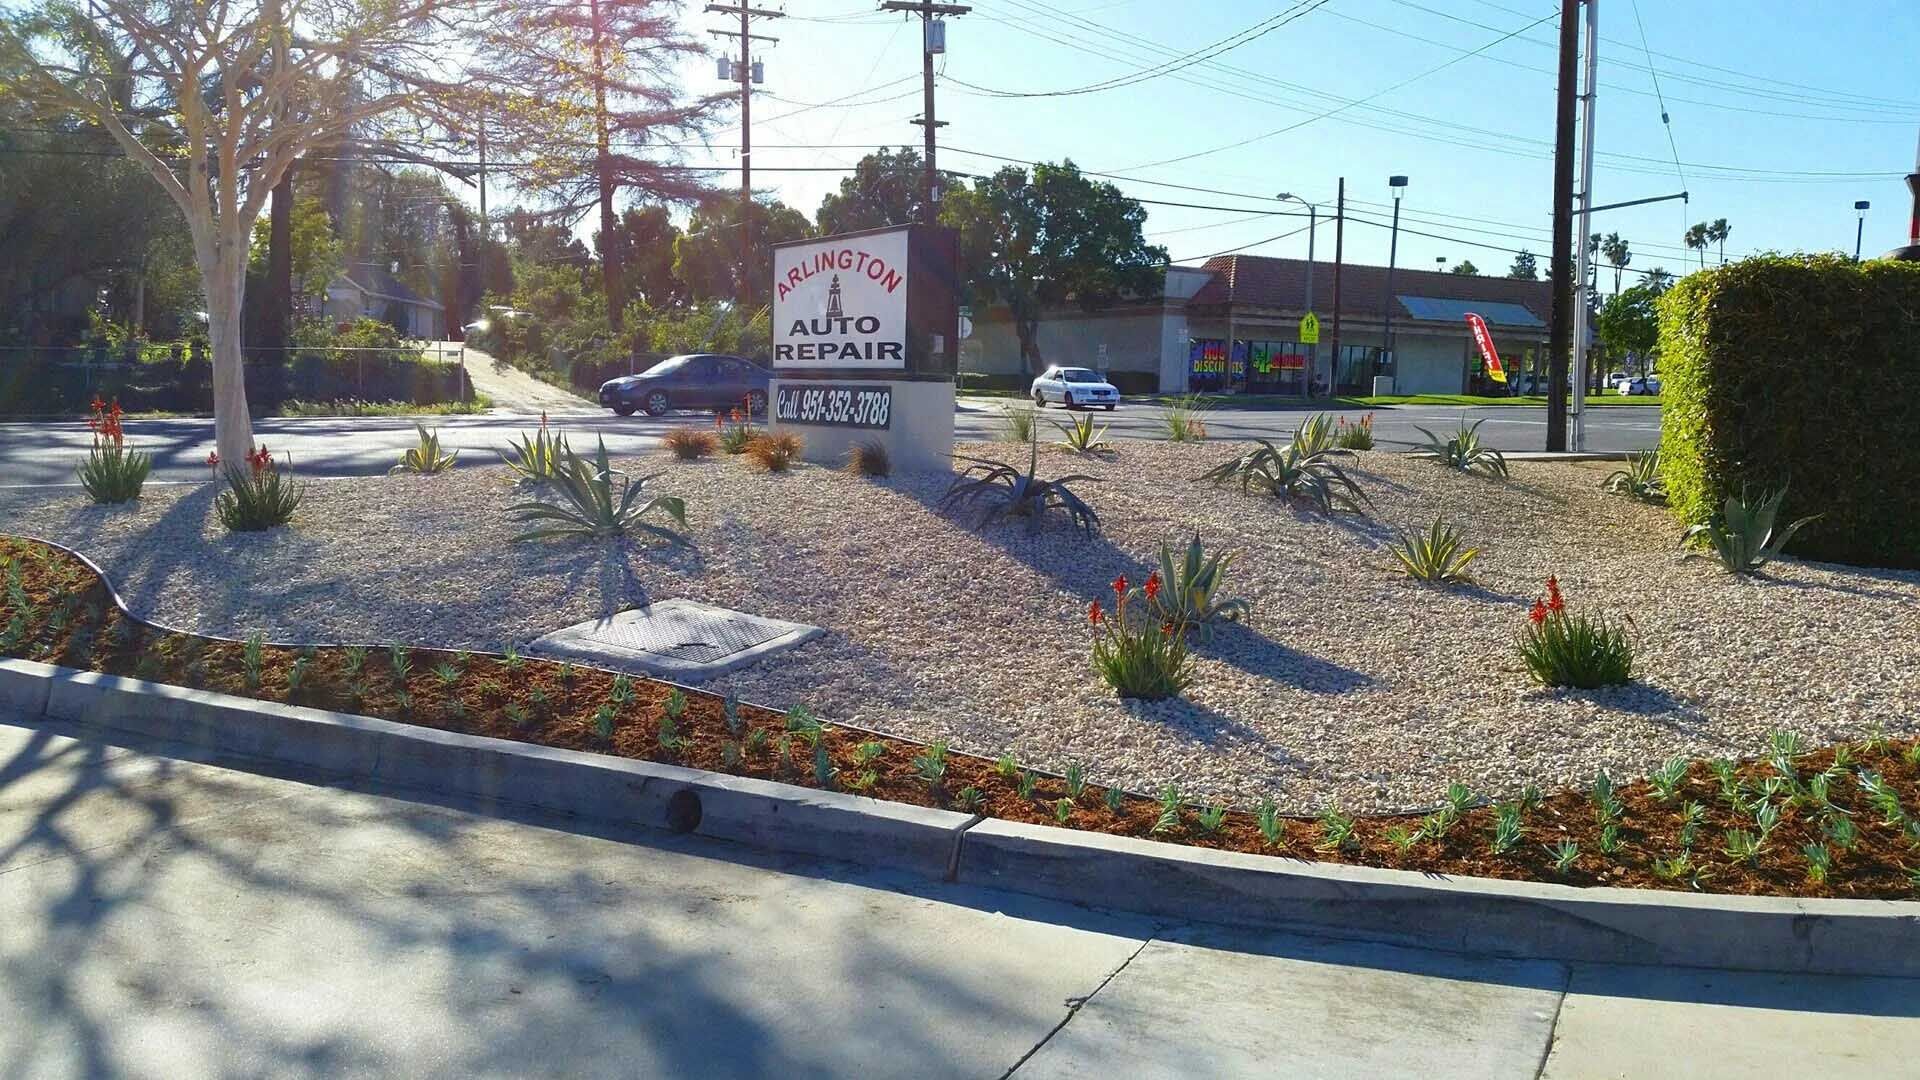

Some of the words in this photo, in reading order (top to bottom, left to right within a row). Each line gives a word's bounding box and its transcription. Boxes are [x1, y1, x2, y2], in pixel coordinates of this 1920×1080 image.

[776, 249, 903, 302] ARLINGTON
[789, 316, 881, 337] AUTO
[1470, 316, 1494, 370] THRIFT
[775, 342, 903, 361] REPAIR
[776, 389, 799, 420] Call
[801, 389, 890, 426] 951-352-3788
